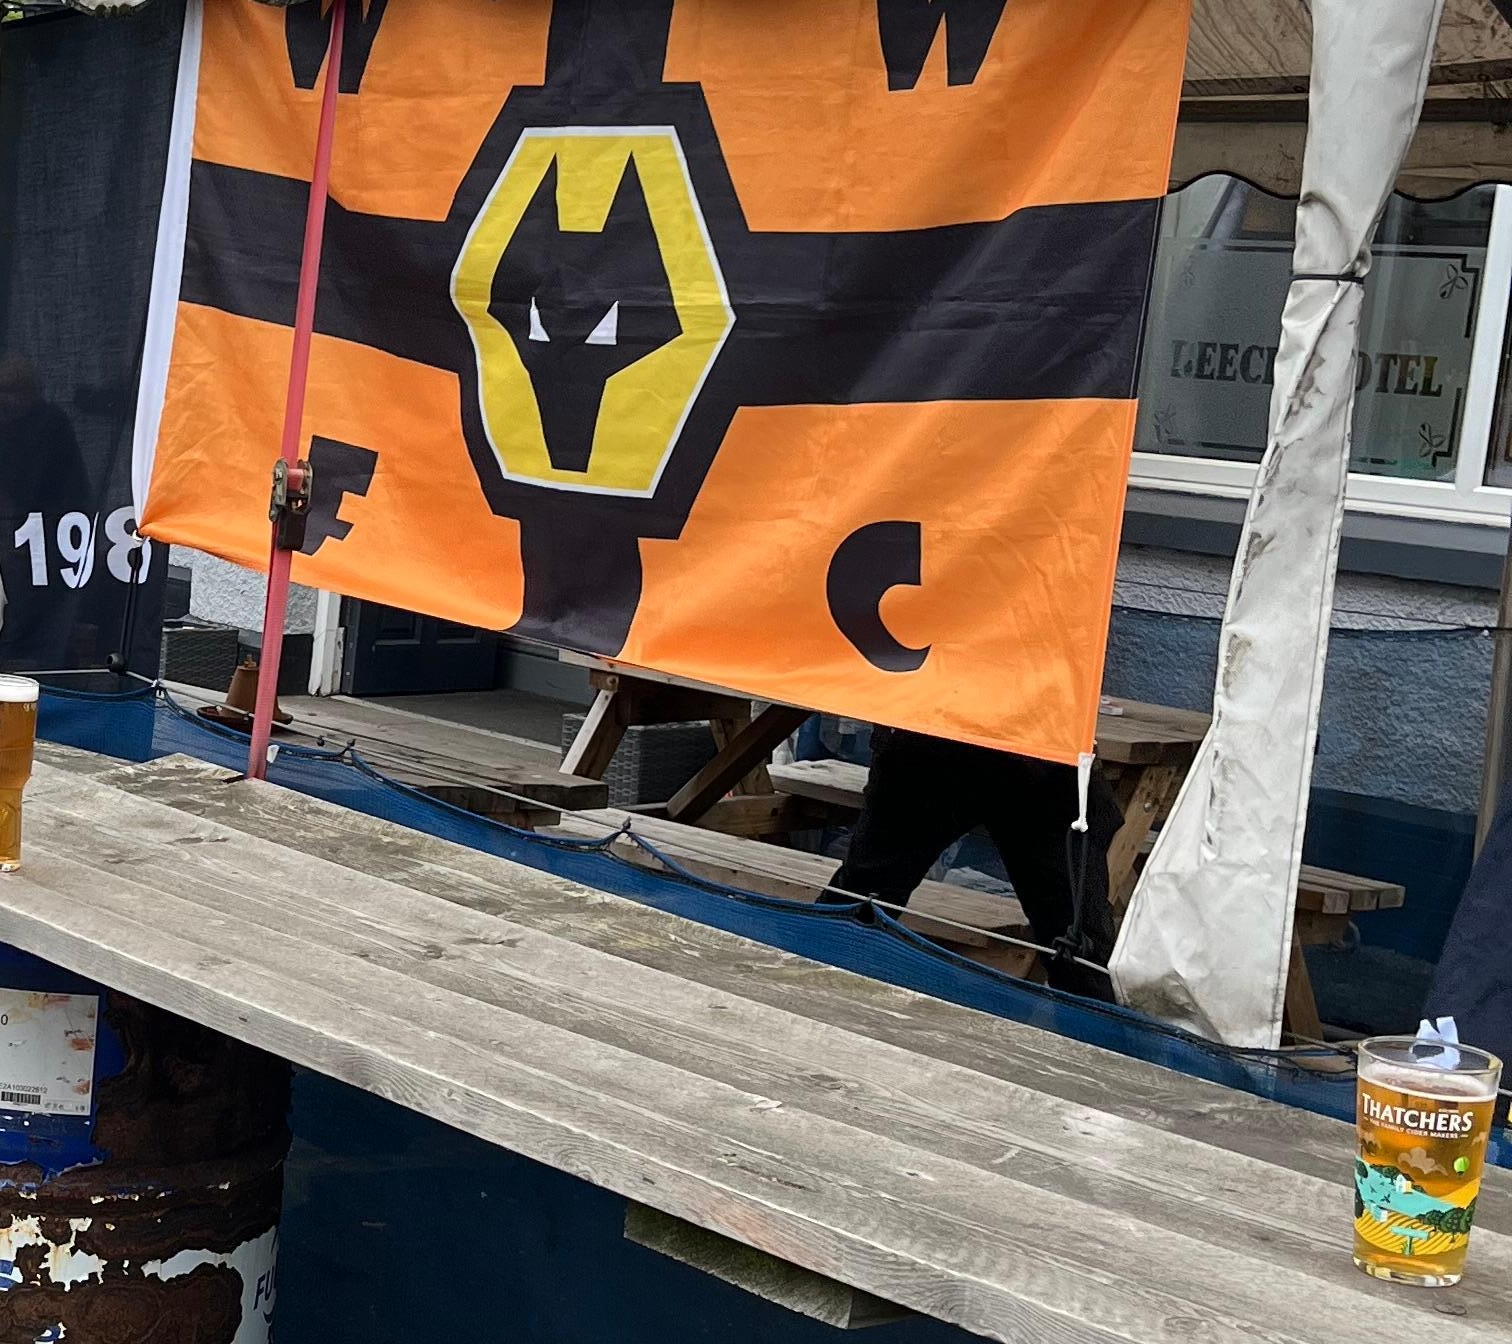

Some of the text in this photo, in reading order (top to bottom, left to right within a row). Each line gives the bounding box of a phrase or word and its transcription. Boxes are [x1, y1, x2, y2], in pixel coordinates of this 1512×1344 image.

[1170, 339, 1443, 397] BEEC OTEL
[298, 434, 932, 673] F C
[1362, 1092, 1474, 1132] THATCHERS
